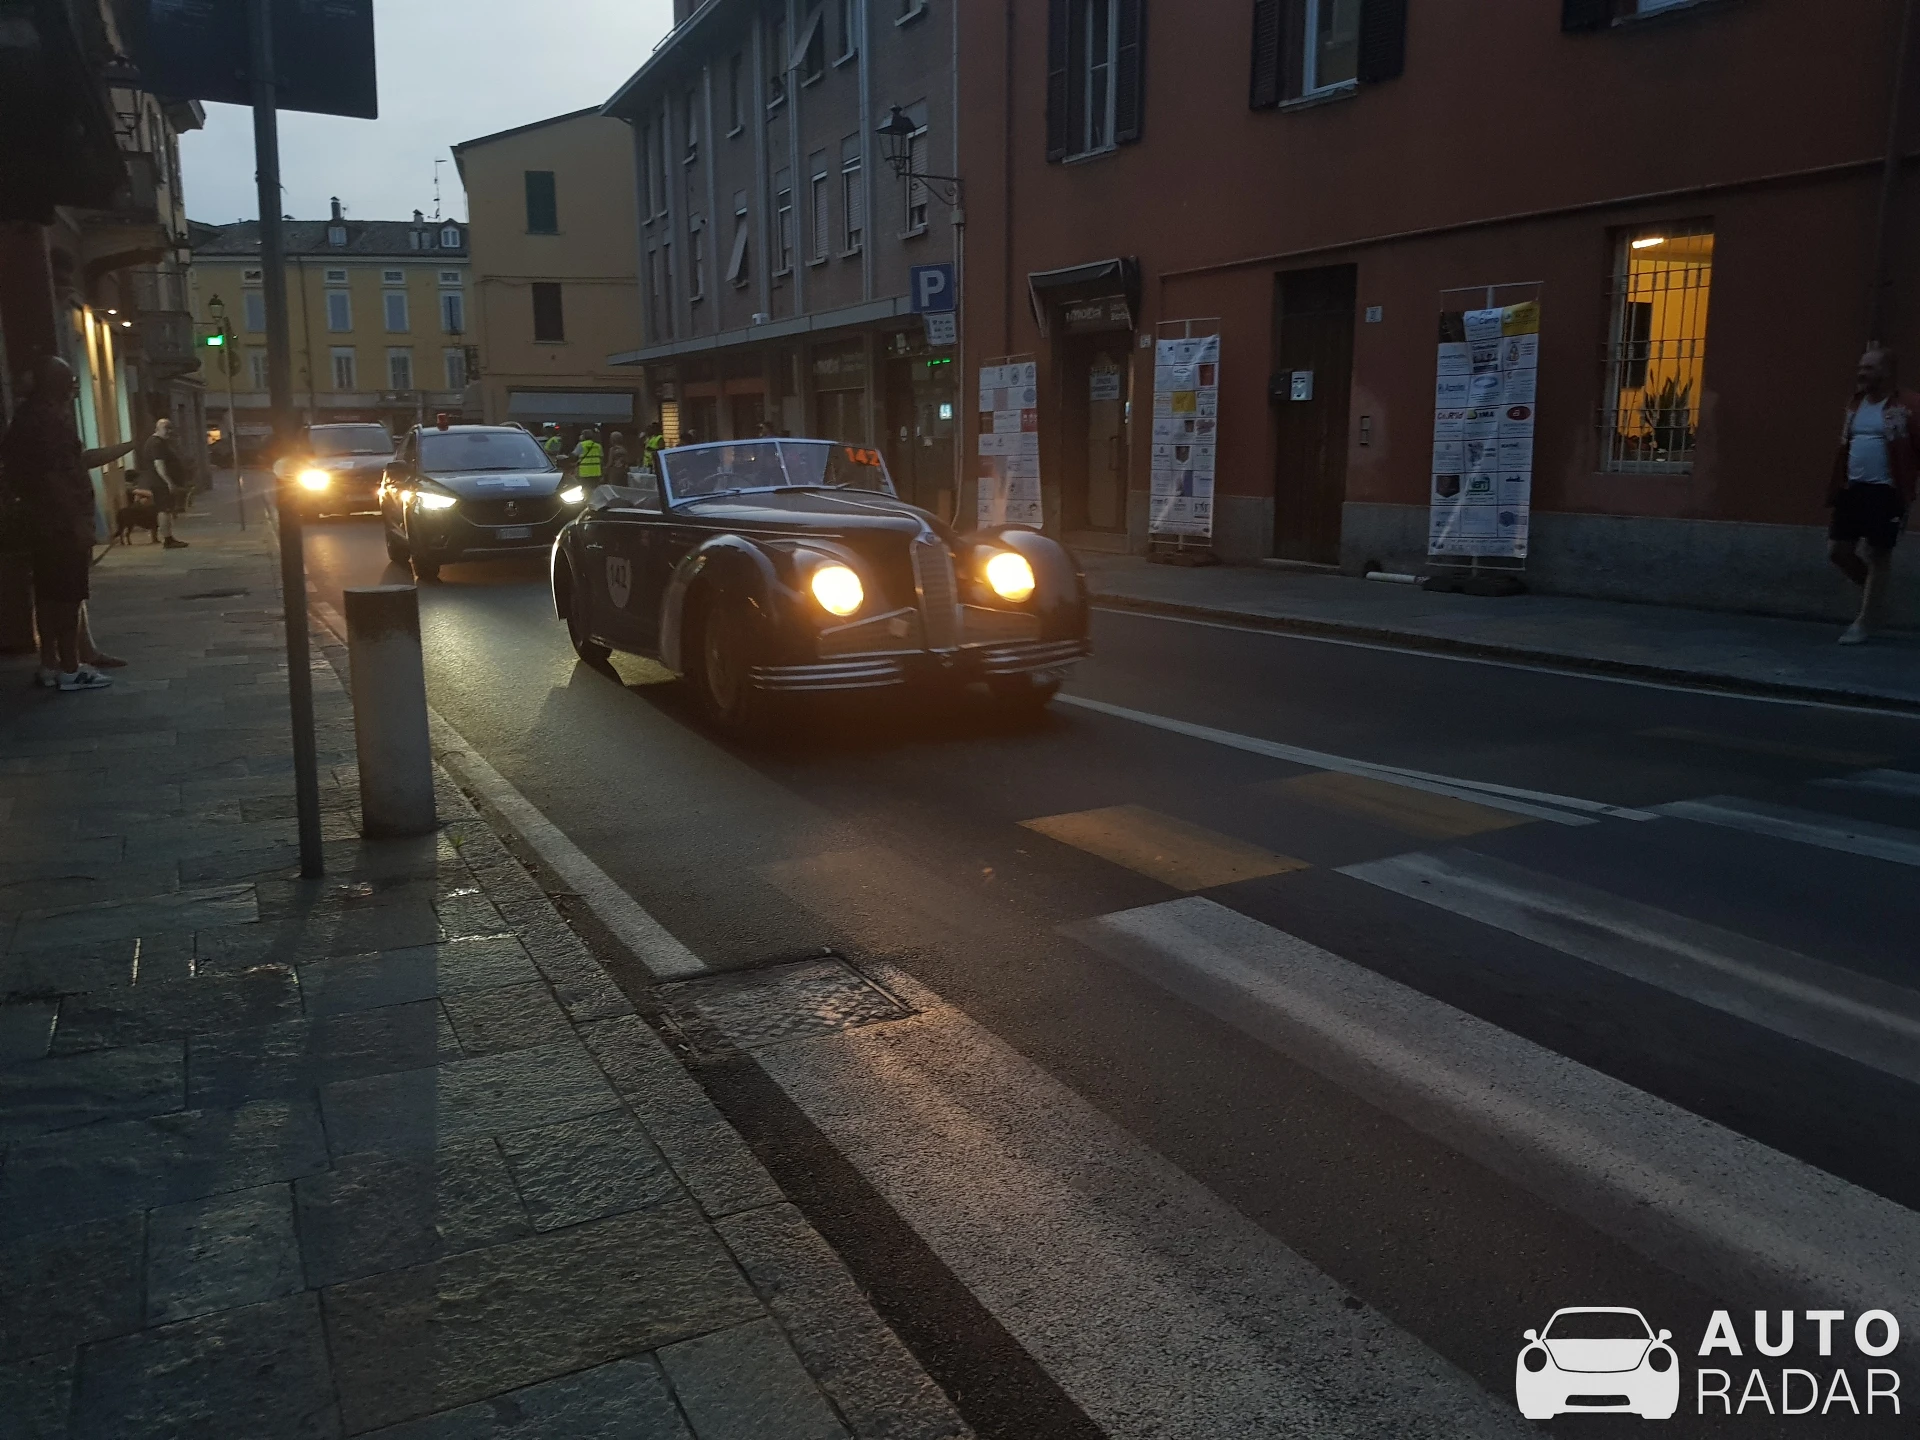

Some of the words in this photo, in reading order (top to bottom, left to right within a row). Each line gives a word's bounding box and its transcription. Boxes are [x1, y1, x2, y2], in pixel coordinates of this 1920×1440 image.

[920, 270, 946, 307] P
[845, 447, 881, 467] 142
[609, 563, 628, 590] 142
